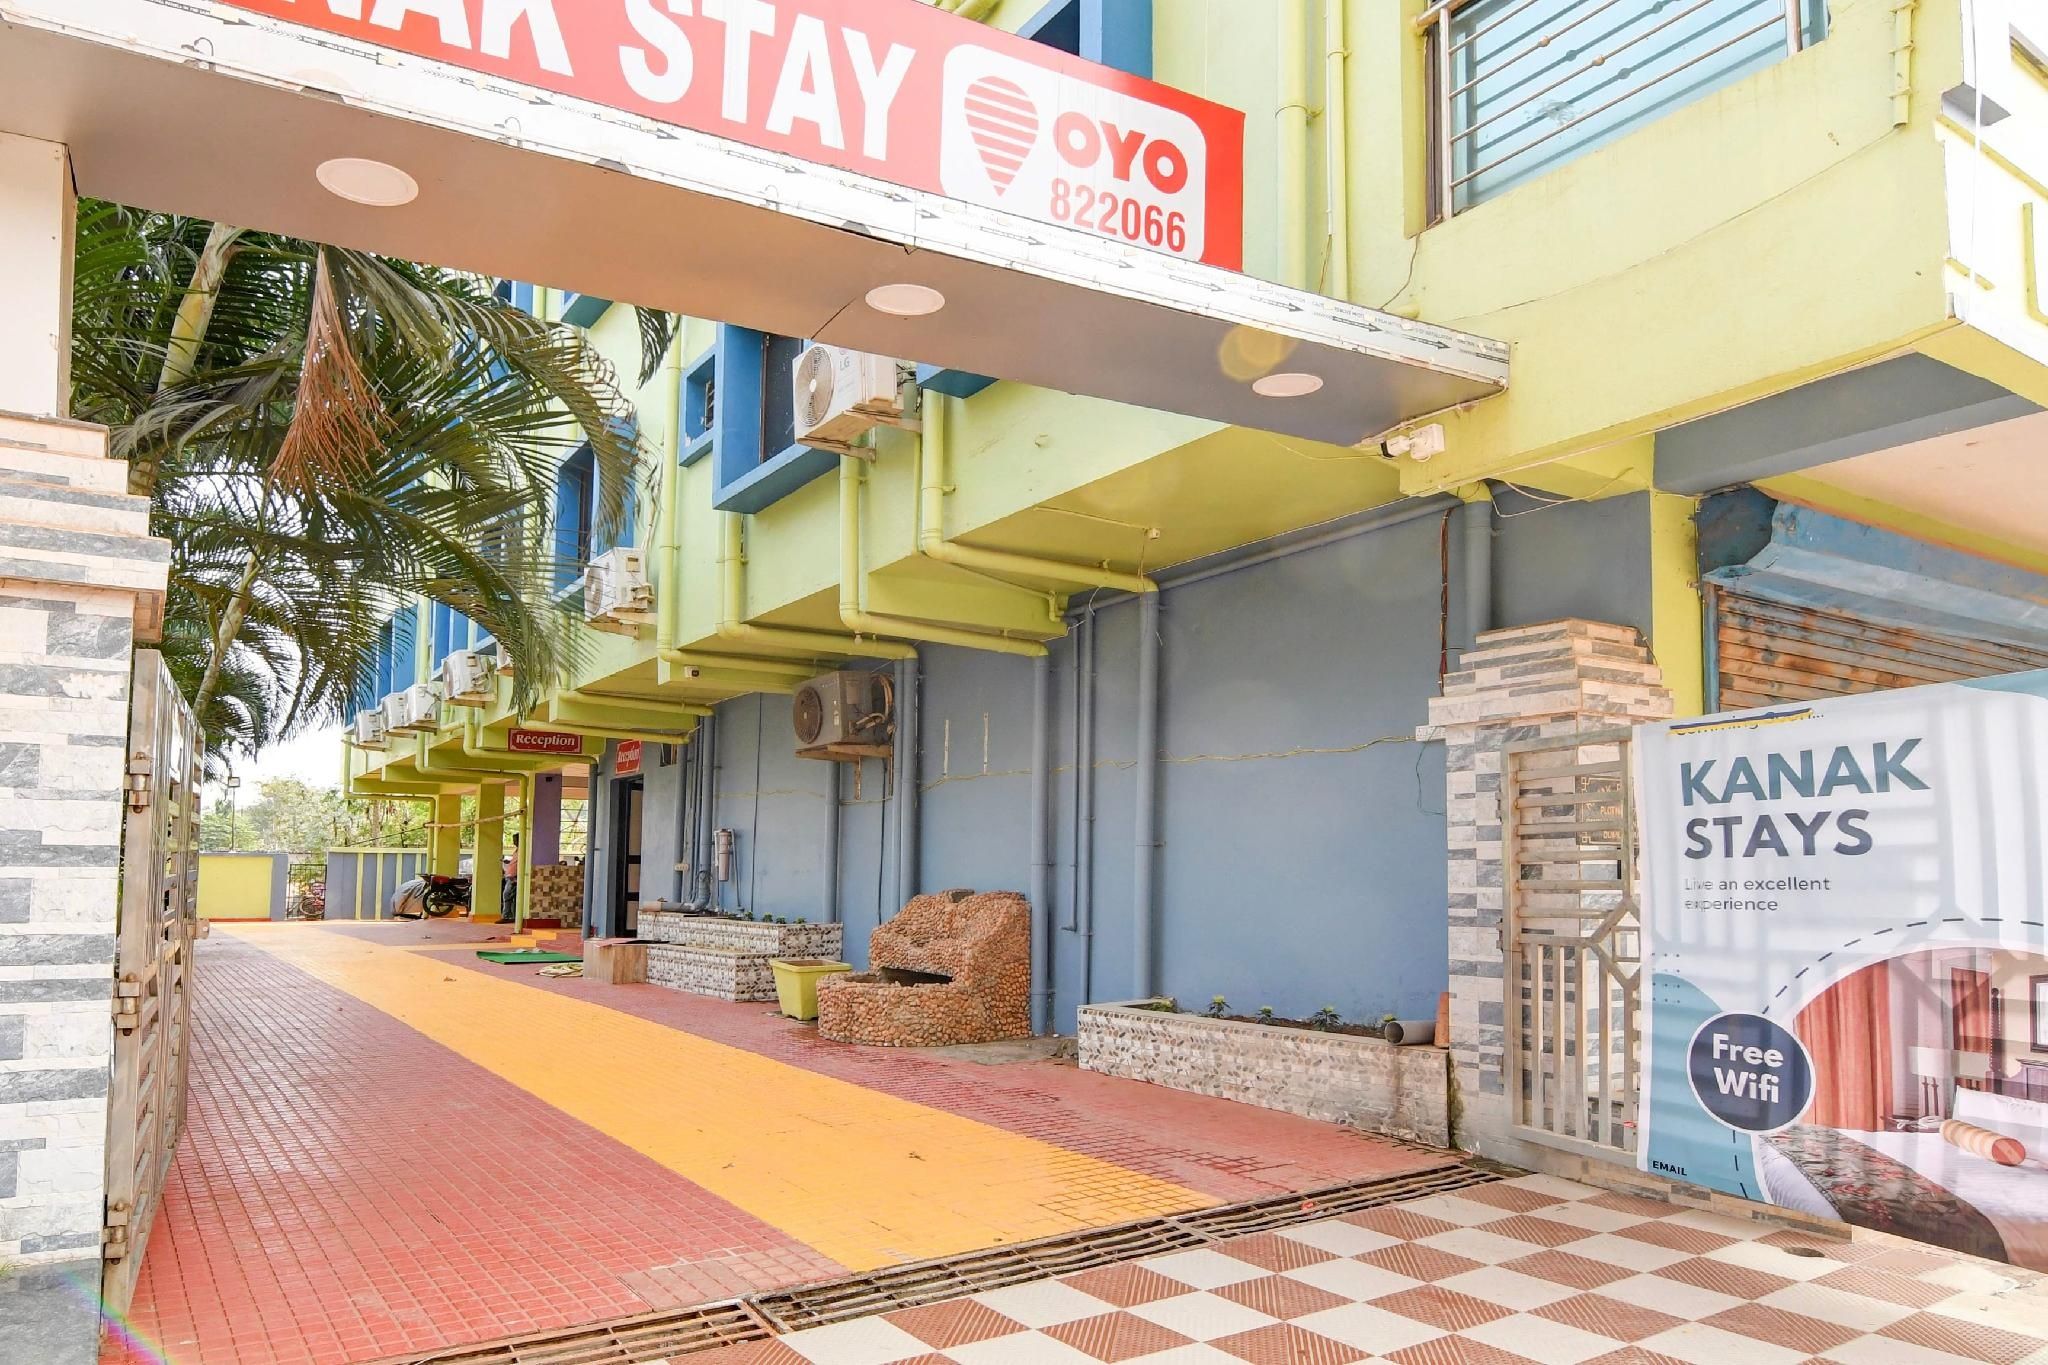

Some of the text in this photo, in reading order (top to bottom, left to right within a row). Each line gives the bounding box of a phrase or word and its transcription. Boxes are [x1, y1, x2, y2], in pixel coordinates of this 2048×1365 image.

[619, 0, 915, 161] STAY
[1053, 110, 1189, 195] OYO
[1049, 177, 1187, 253] 822066
[515, 733, 576, 749] Reception
[1680, 738, 1931, 806] KANAK
[1684, 808, 1873, 859] STAYS
[1684, 876, 1832, 891] Live an excellent
[1684, 896, 1779, 912] experience
[1713, 1032, 1784, 1067] Free
[1713, 1066, 1780, 1104] Wifi
[1652, 1160, 1688, 1177] EMAIL
